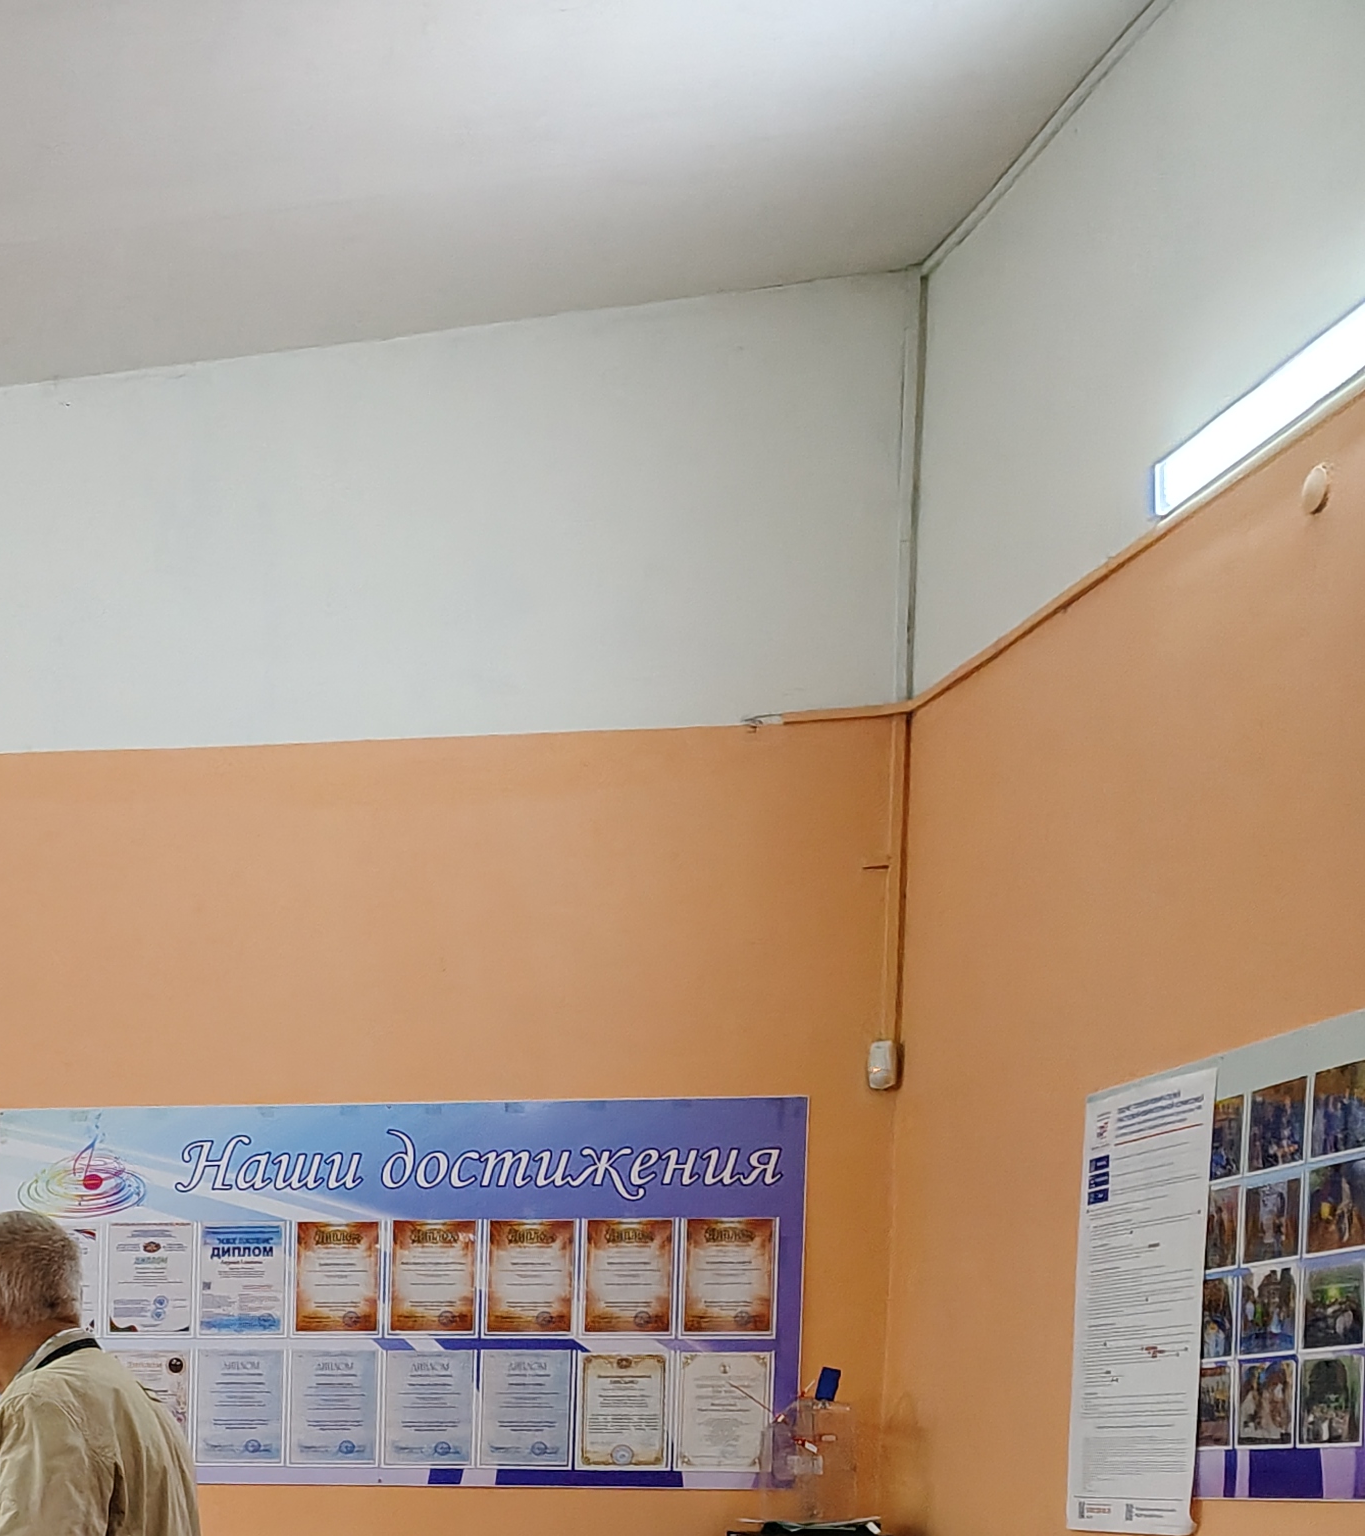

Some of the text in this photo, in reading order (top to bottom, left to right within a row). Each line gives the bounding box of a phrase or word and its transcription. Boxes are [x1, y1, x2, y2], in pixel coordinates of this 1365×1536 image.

[174, 1128, 784, 1201] Наши достижения
[210, 1246, 274, 1259] ДИПЛОМ
